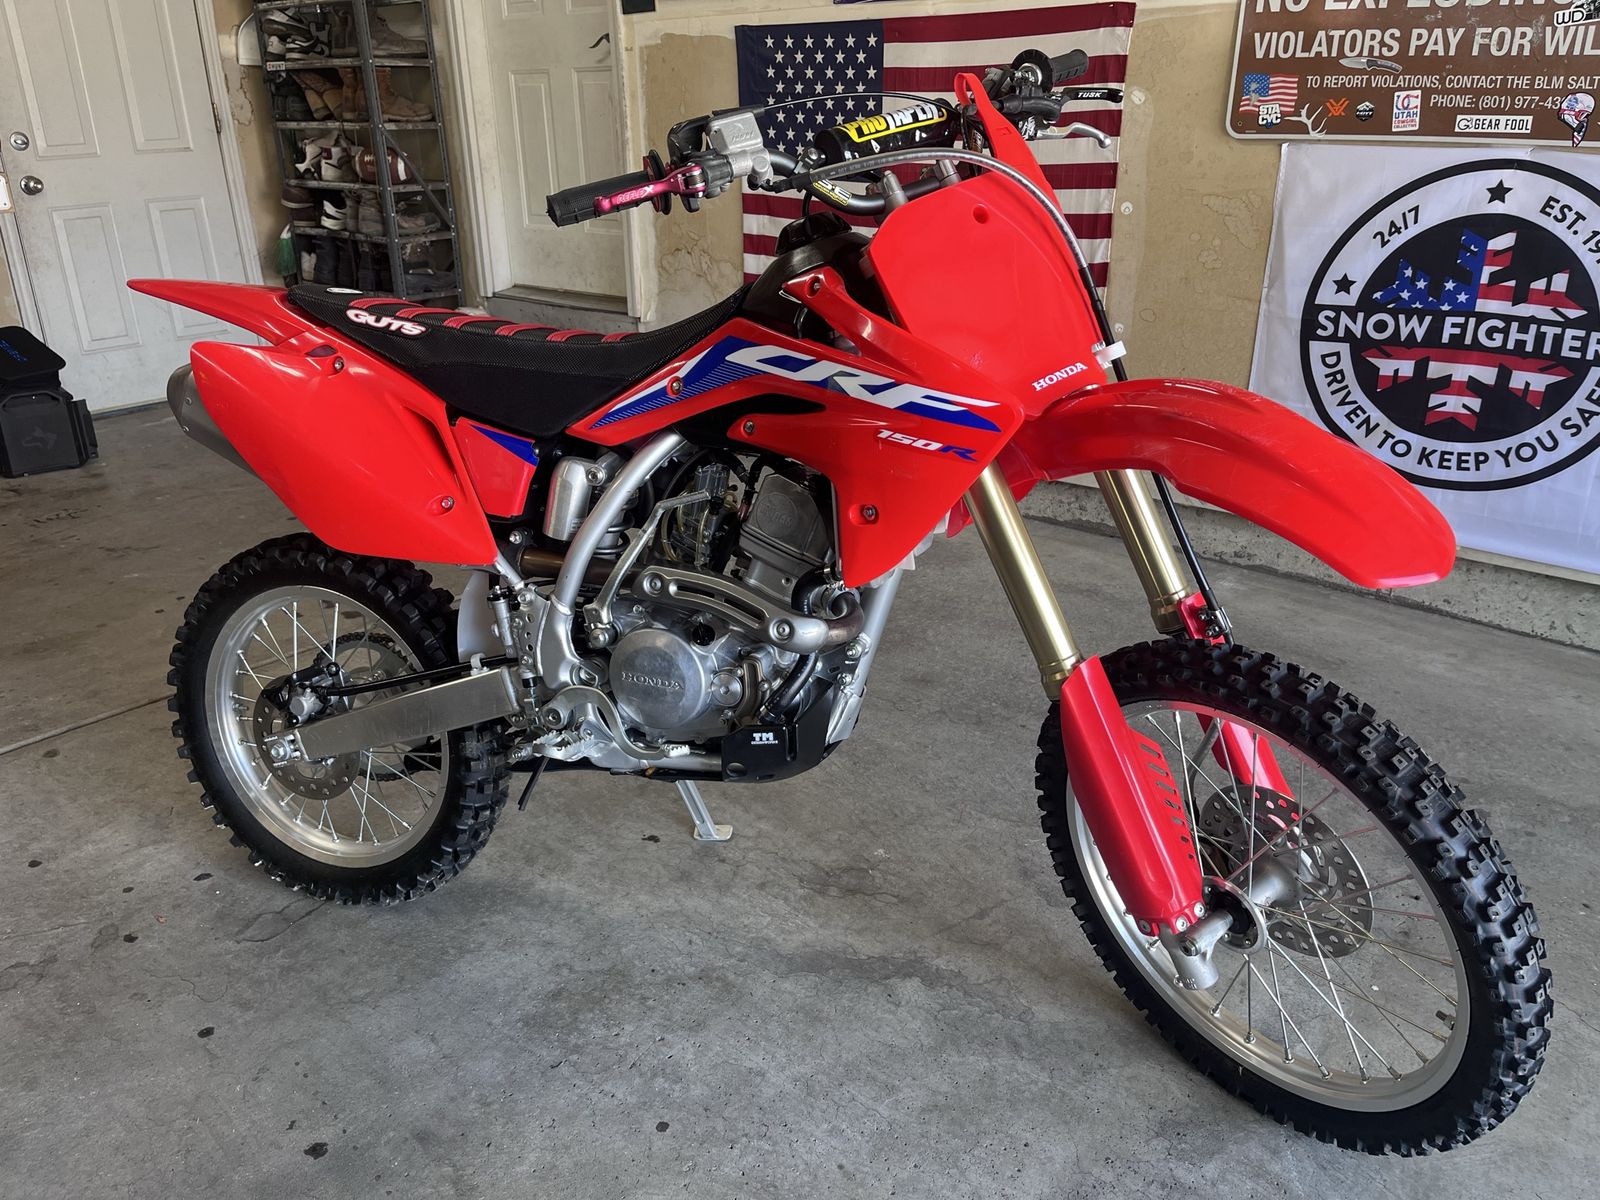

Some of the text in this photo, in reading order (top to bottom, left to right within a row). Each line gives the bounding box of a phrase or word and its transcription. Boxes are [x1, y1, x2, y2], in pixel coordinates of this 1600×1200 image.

[1254, 28, 1401, 58] VIOLATORS
[1408, 27, 1465, 57] PAY
[1471, 27, 1533, 57] FOR
[1306, 75, 1600, 89] TO REPORT VIOLATIONS, CONTACT THE BLM SALT
[1394, 110, 1418, 119] UTAH
[1430, 94, 1565, 111] PHONE: (801) 977-43
[1474, 118, 1530, 131] GEAR FOOL
[1372, 205, 1421, 249] 24/7
[1539, 195, 1587, 236] EST.
[346, 309, 427, 336] GUTS
[1316, 310, 1432, 343] SNOW
[725, 345, 1001, 410] CRF
[1032, 362, 1088, 391] HONDA
[1320, 350, 1380, 438] DRIVEN
[1376, 430, 1412, 458] TO
[1417, 446, 1490, 472] KEEP
[1494, 429, 1559, 468] YOU
[621, 671, 683, 690] HONDA
[753, 732, 774, 742] TM
